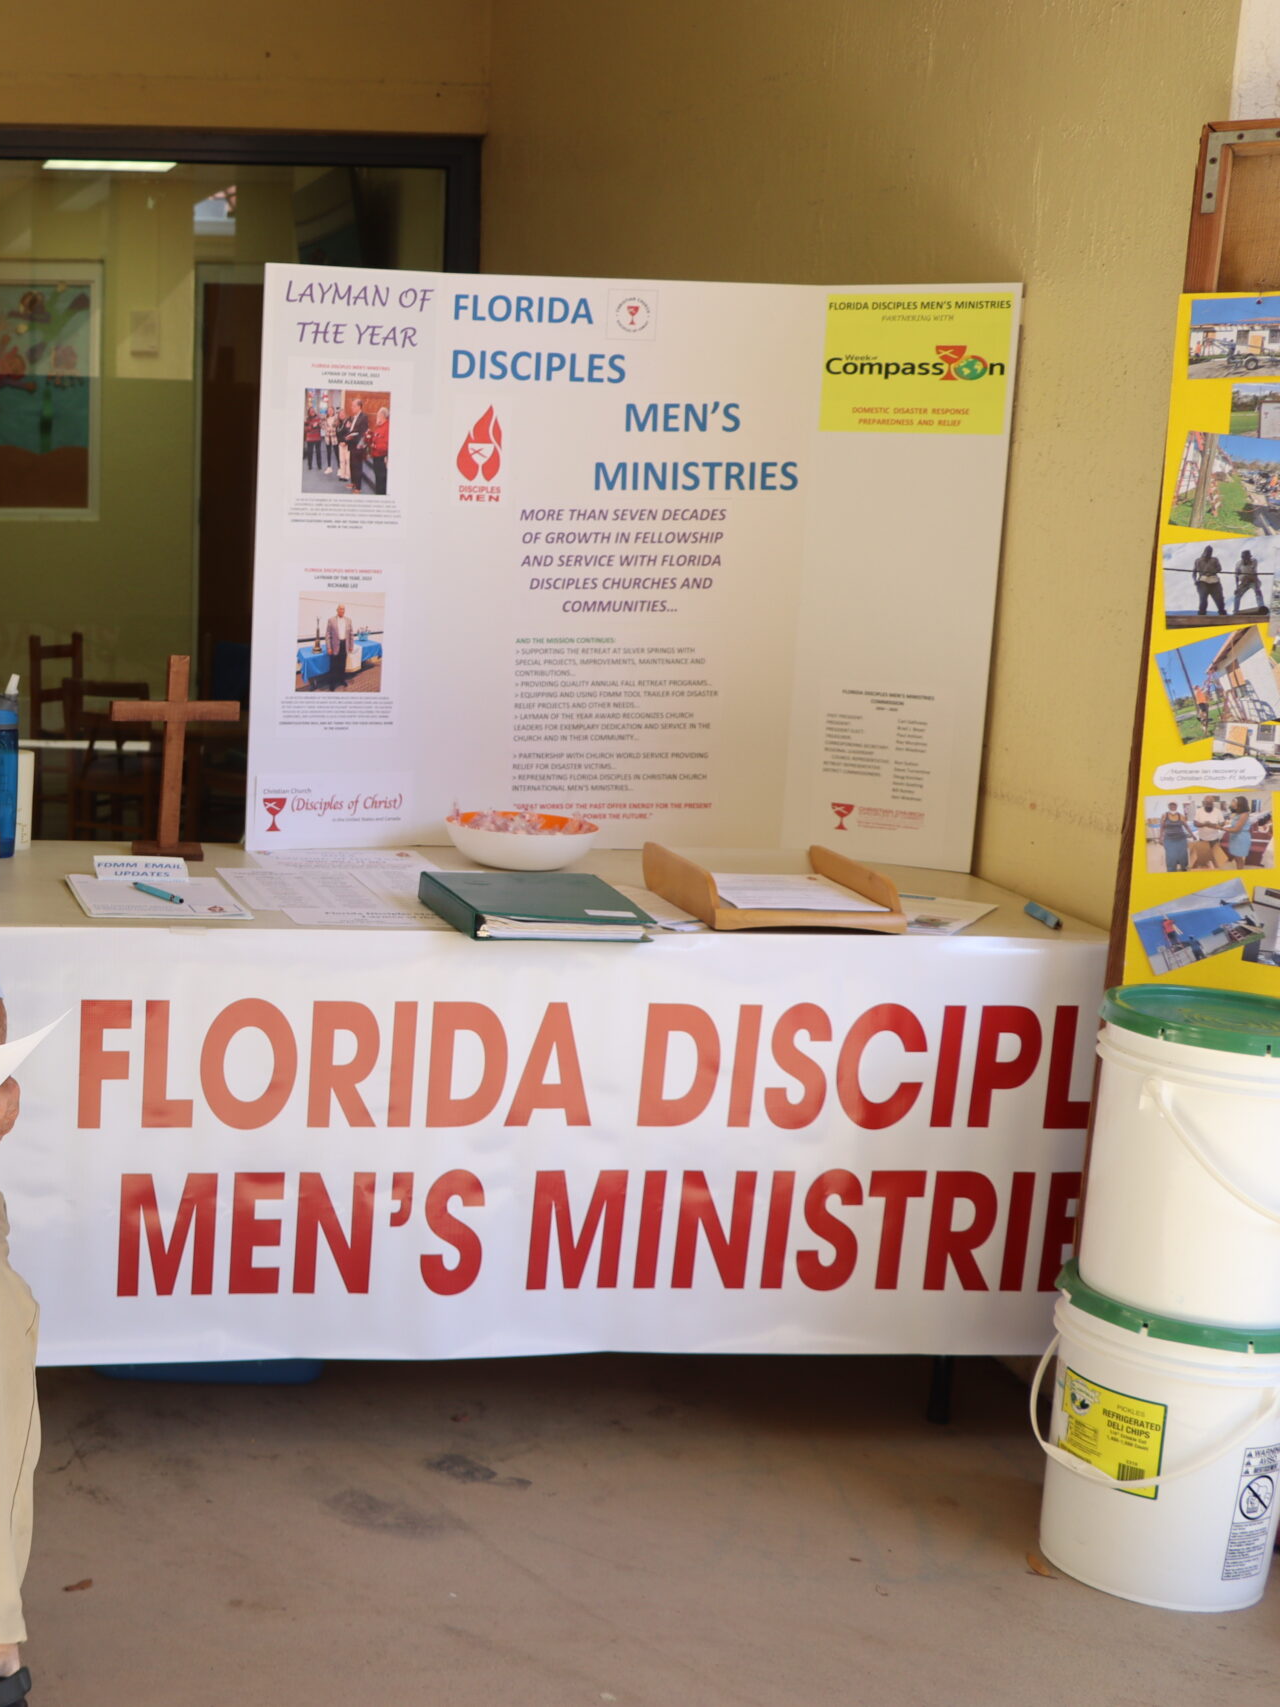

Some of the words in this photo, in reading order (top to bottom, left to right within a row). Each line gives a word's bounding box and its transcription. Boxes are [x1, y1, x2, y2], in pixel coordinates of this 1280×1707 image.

[285, 280, 390, 306] LAYMAN
[399, 287, 434, 312] OF
[829, 301, 868, 311] FLORIDA
[870, 301, 917, 310] DISCIPLES
[919, 300, 951, 310] MEN'S
[953, 300, 1011, 309] MINISTRIES
[453, 294, 594, 325] FLORIDA
[297, 321, 347, 344] THE
[355, 324, 418, 348] YEAR
[451, 349, 627, 383] DISCIPLES
[625, 401, 742, 433] MEN'S
[892, 407, 928, 415] DISASTER
[858, 418, 914, 426] PREPAREDNESS
[593, 461, 799, 491] MINISTRIES
[458, 485, 501, 494] DISCIPLES
[459, 494, 500, 502] MEN
[520, 508, 565, 522] MORE
[568, 508, 608, 522] THAN
[612, 508, 657, 522] SEVEN
[661, 508, 726, 522] DECADES
[522, 531, 541, 545] OF
[544, 531, 611, 545] GROWTH
[614, 531, 630, 545] IN
[634, 531, 723, 545] FELLOWSHIP
[522, 554, 553, 568] AND
[557, 554, 615, 568] SERVICE
[619, 554, 657, 568] WITH
[660, 554, 721, 568] FLORIDA
[529, 577, 598, 590] DISCIPLES
[601, 577, 676, 590] CHURCHES
[680, 577, 713, 590] AND
[291, 795, 343, 816] (Disciples
[348, 793, 360, 816] of
[363, 793, 403, 810] Christ)
[77, 997, 591, 1129] FLORIDA
[116, 1167, 485, 1298] MEN'S
[1103, 1408, 1161, 1432] REFRIGERATED
[1117, 1404, 1145, 1417] PICKLES
[1107, 1420, 1124, 1432] DELI
[1126, 1427, 1150, 1439] CHIPS
